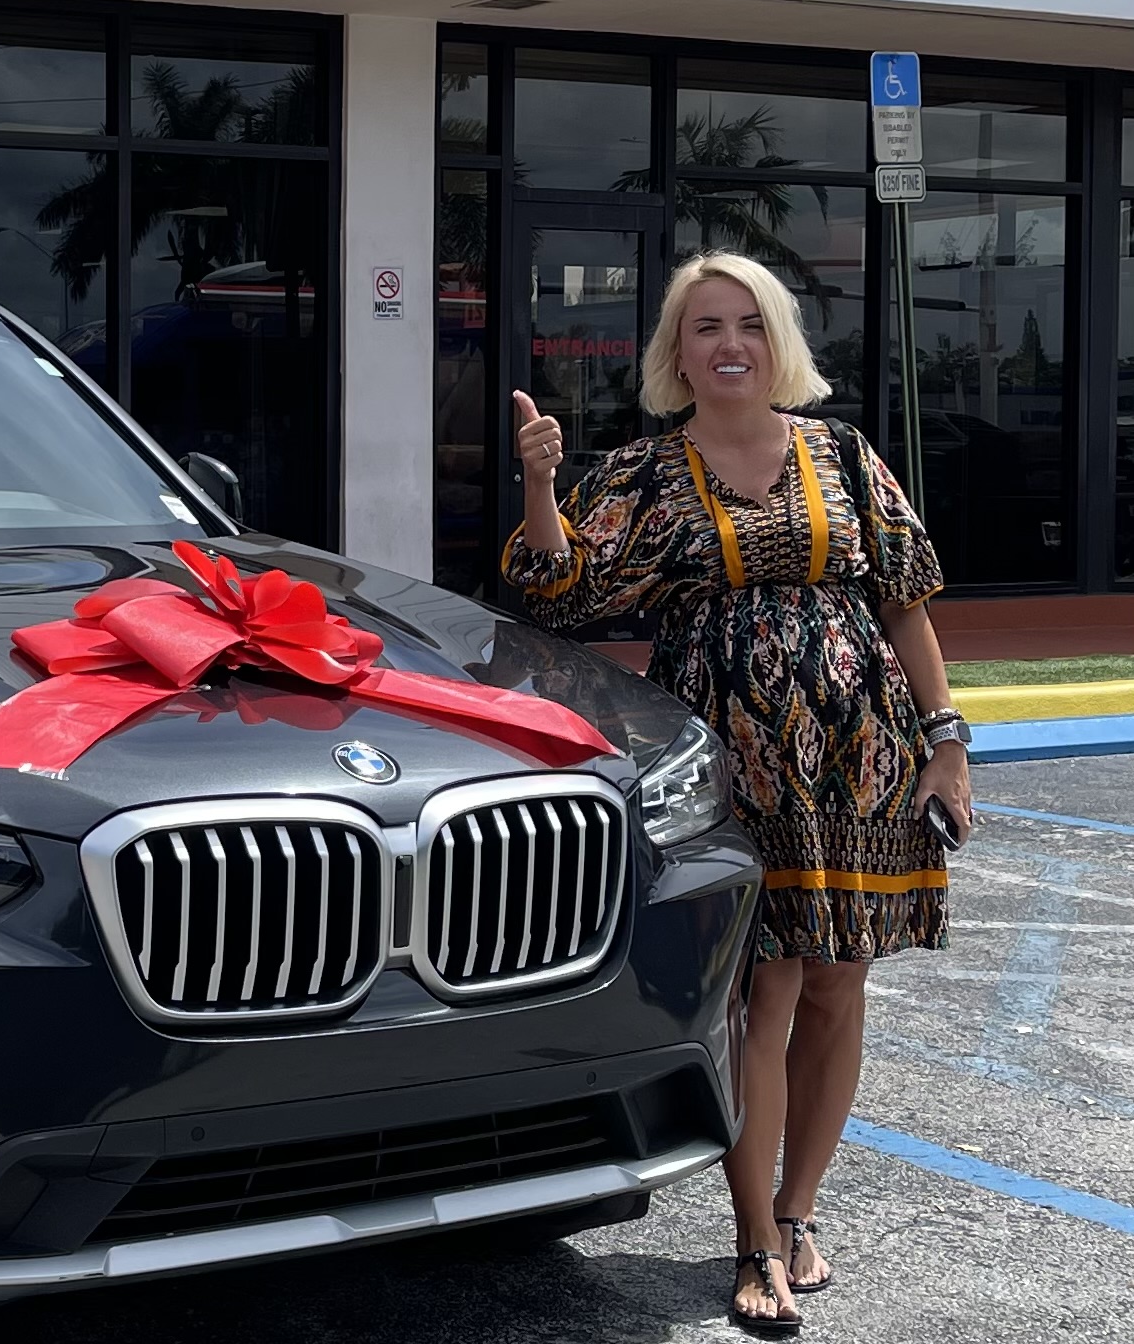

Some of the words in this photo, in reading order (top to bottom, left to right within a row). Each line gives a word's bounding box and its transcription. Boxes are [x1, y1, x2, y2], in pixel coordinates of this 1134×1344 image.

[902, 174, 921, 192] FINE
[374, 301, 387, 313] NO
[532, 338, 635, 357] ENTRANCE
